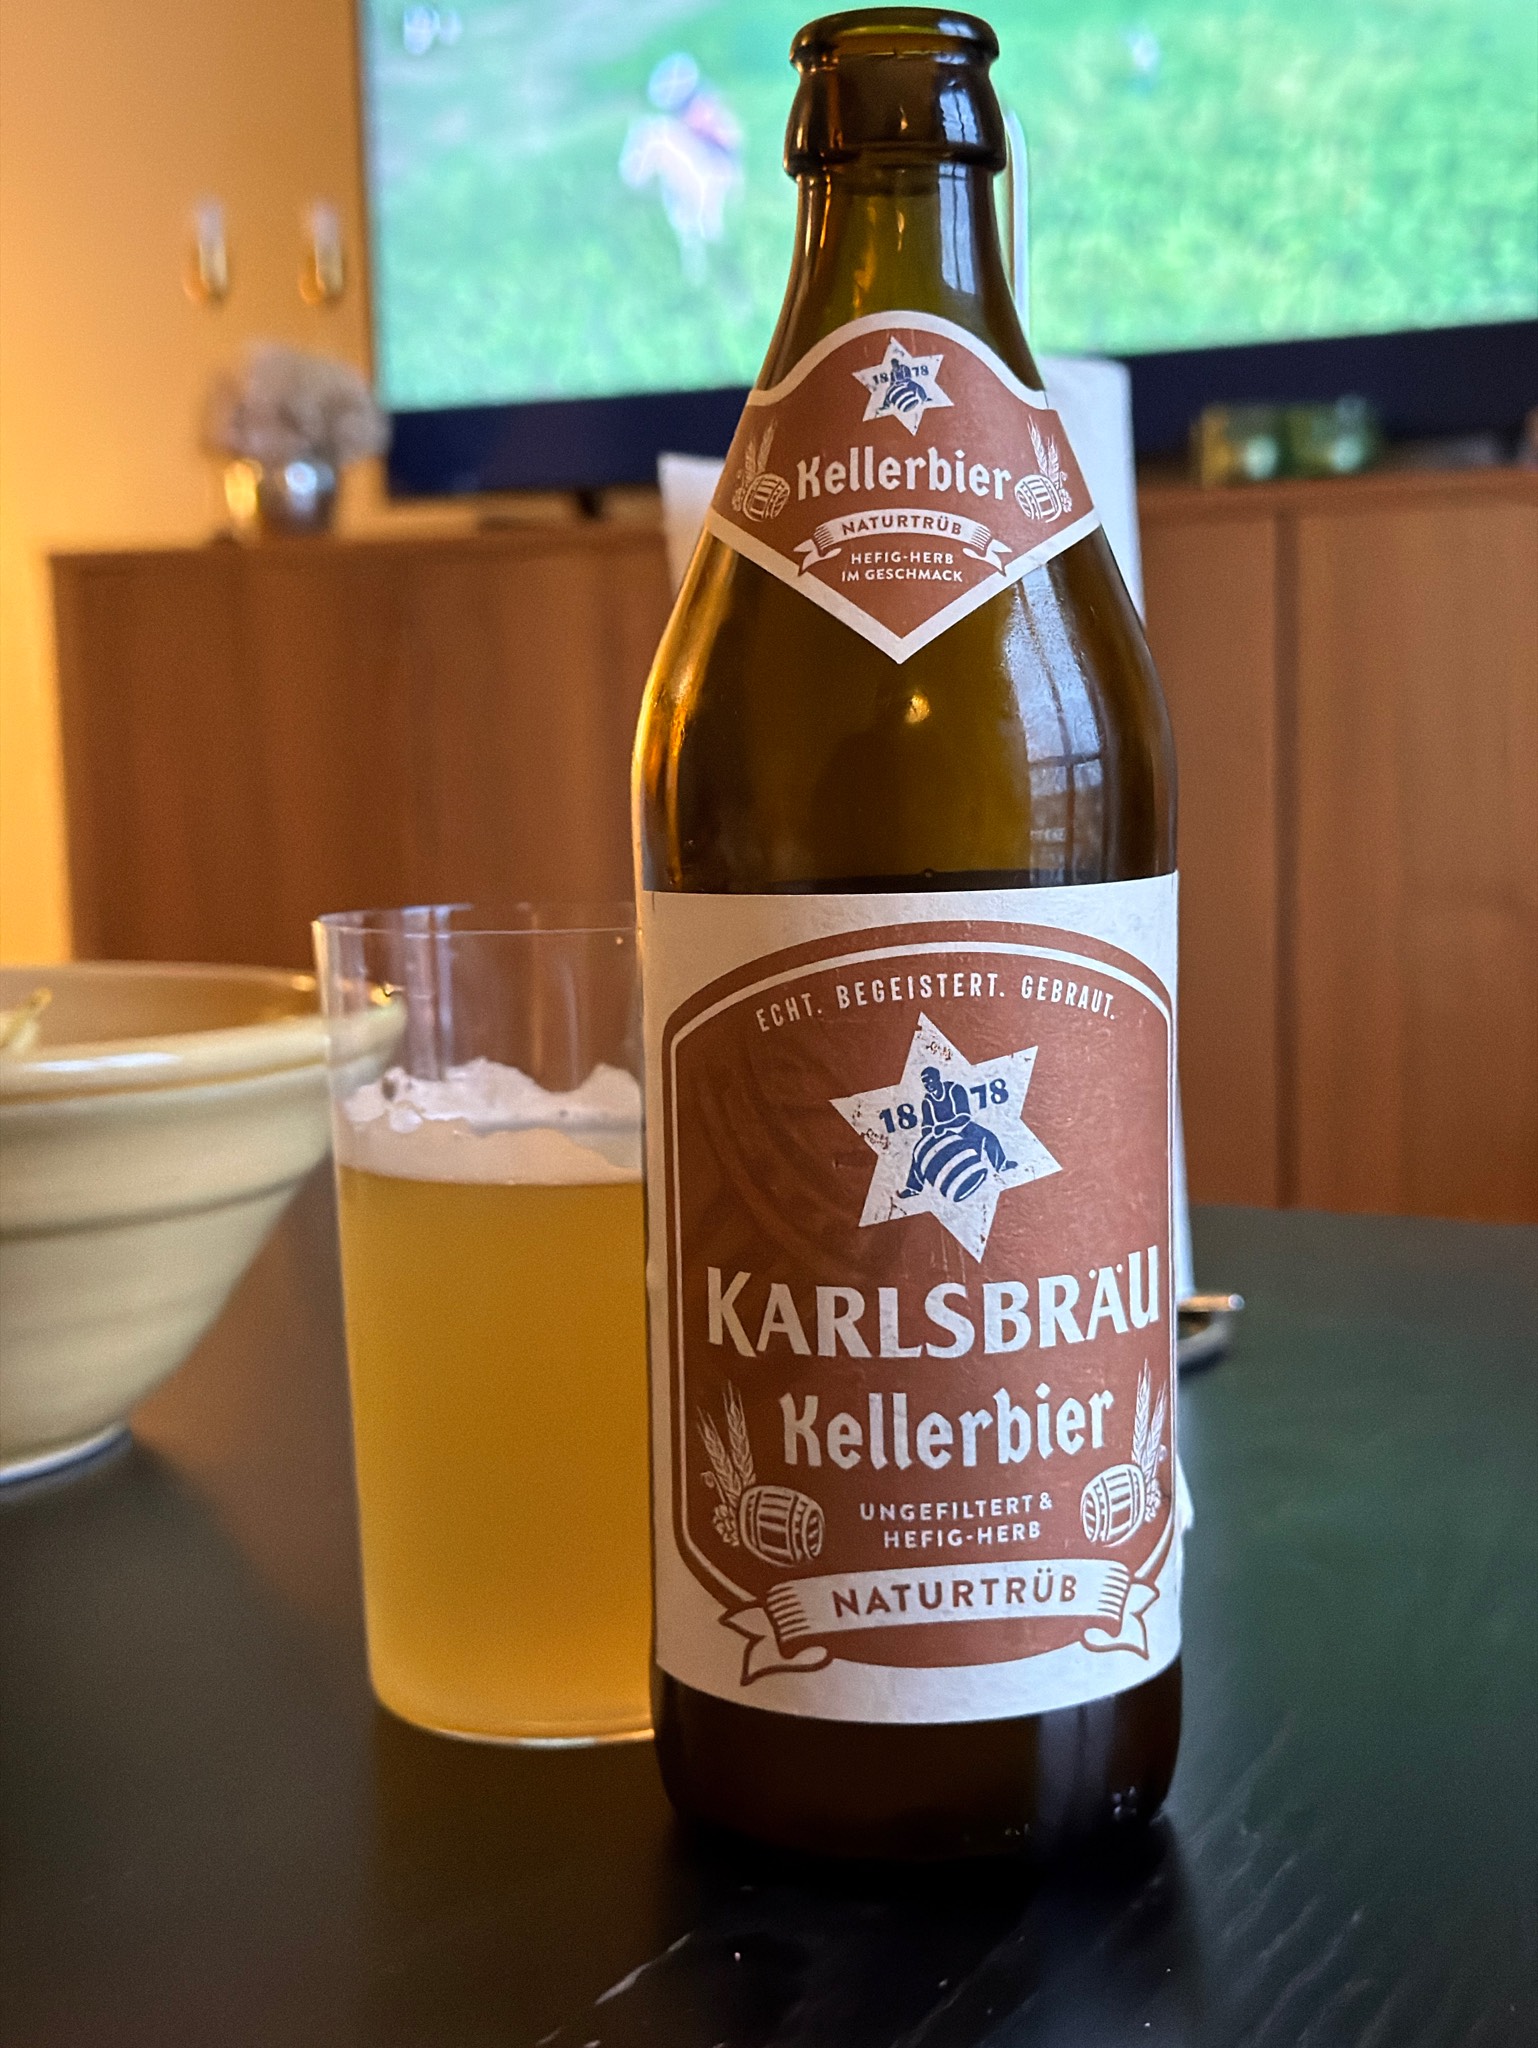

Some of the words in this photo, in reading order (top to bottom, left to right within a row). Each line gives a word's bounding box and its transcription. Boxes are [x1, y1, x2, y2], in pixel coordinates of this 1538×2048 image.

[872, 371, 889, 383] 18
[912, 363, 929, 377] 78
[797, 446, 1011, 501] Kellerbier
[842, 514, 962, 536] NATURTRÜB
[842, 570, 859, 582] IM
[865, 568, 963, 582] GESCHMACK
[851, 552, 954, 565] HEFIG-HERB
[756, 995, 822, 1032] ECHT.
[836, 973, 1004, 1009] BEGEISTERT.
[1021, 975, 1115, 1020] GEBRAUT.
[879, 1103, 918, 1133] 18
[970, 1078, 1008, 1110] 78
[706, 1245, 1160, 1359] KARLSBRÄU
[779, 1383, 1115, 1470] Kellerbier
[860, 1495, 1032, 1521] UNGEFILTERT
[1038, 1492, 1053, 1510] &
[884, 1521, 1041, 1549] HEFIG-HERB
[832, 1569, 1078, 1618] NATURTRÜB
